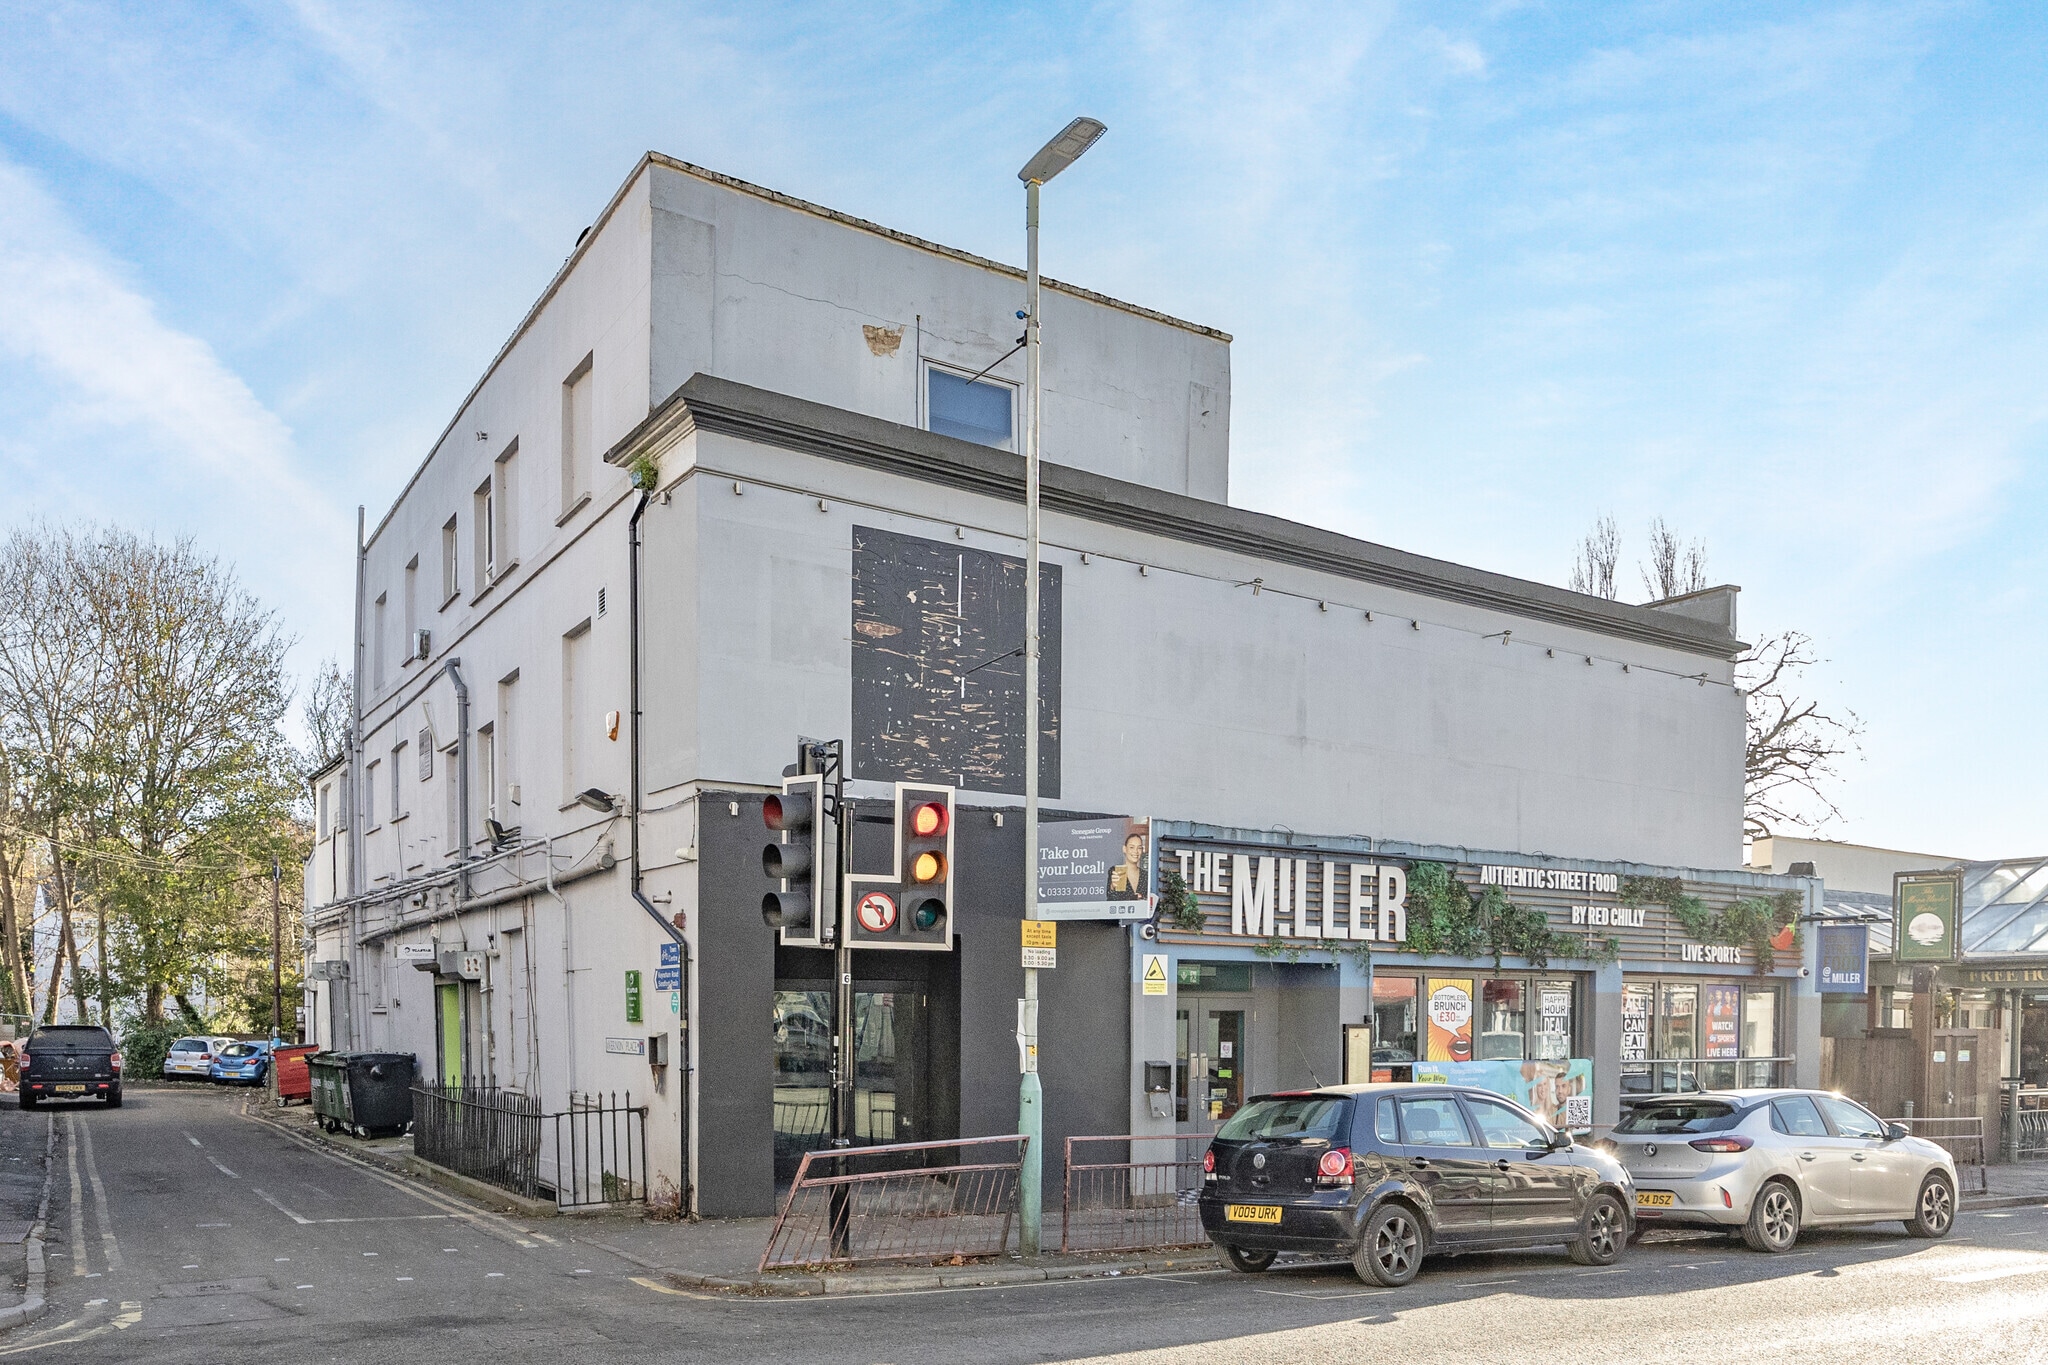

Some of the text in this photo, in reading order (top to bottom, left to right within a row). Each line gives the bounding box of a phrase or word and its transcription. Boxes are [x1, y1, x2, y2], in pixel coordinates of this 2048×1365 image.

[1040, 847, 1088, 860] Take on
[1039, 861, 1105, 878] your local!
[1176, 850, 1227, 893] THE
[1480, 865, 1617, 892] AUTHENTIC STREET FOOD
[1047, 887, 1105, 896] 03333 200 036
[1572, 906, 1645, 927] BY RED CHILLY
[1682, 944, 1740, 963] LIVE SPORTS
[1822, 966, 1831, 977] @
[1969, 970, 2018, 982] FREE
[844, 975, 849, 983] 6
[1434, 1002, 1466, 1010] BRUNCH
[1544, 996, 1566, 1005] HAPPY
[1544, 1005, 1566, 1014] HOUR
[1440, 1012, 1456, 1022] £30
[1544, 1017, 1566, 1033] DEAL
[1624, 1019, 1645, 1032] CAN
[1712, 1021, 1733, 1030] WATCH
[1625, 1034, 1644, 1047] EAT
[1717, 1034, 1735, 1042] SPORTS
[1707, 1048, 1737, 1057] LIVE HERE
[1417, 1074, 1447, 1084] Your Way
[1652, 1195, 1671, 1205] DSZ
[1258, 1207, 1278, 1219] URK
